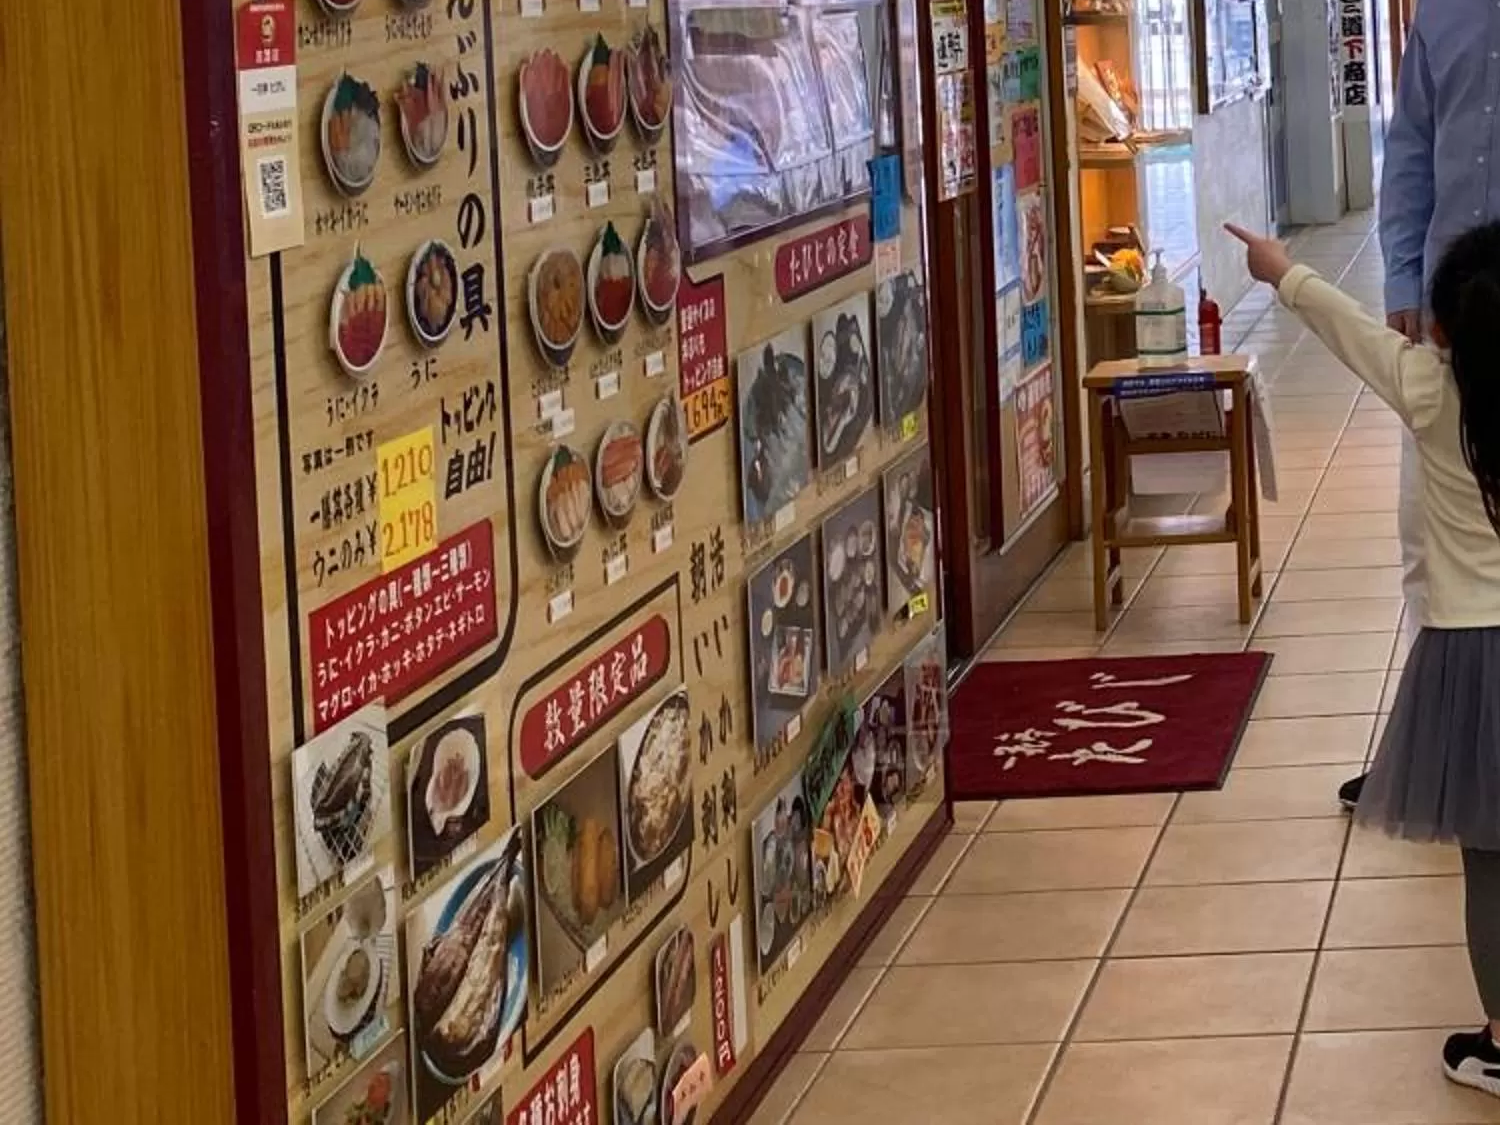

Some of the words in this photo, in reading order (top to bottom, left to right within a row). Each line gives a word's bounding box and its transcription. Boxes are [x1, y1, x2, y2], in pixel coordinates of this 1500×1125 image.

[544, 633, 648, 751] 数量限定品
